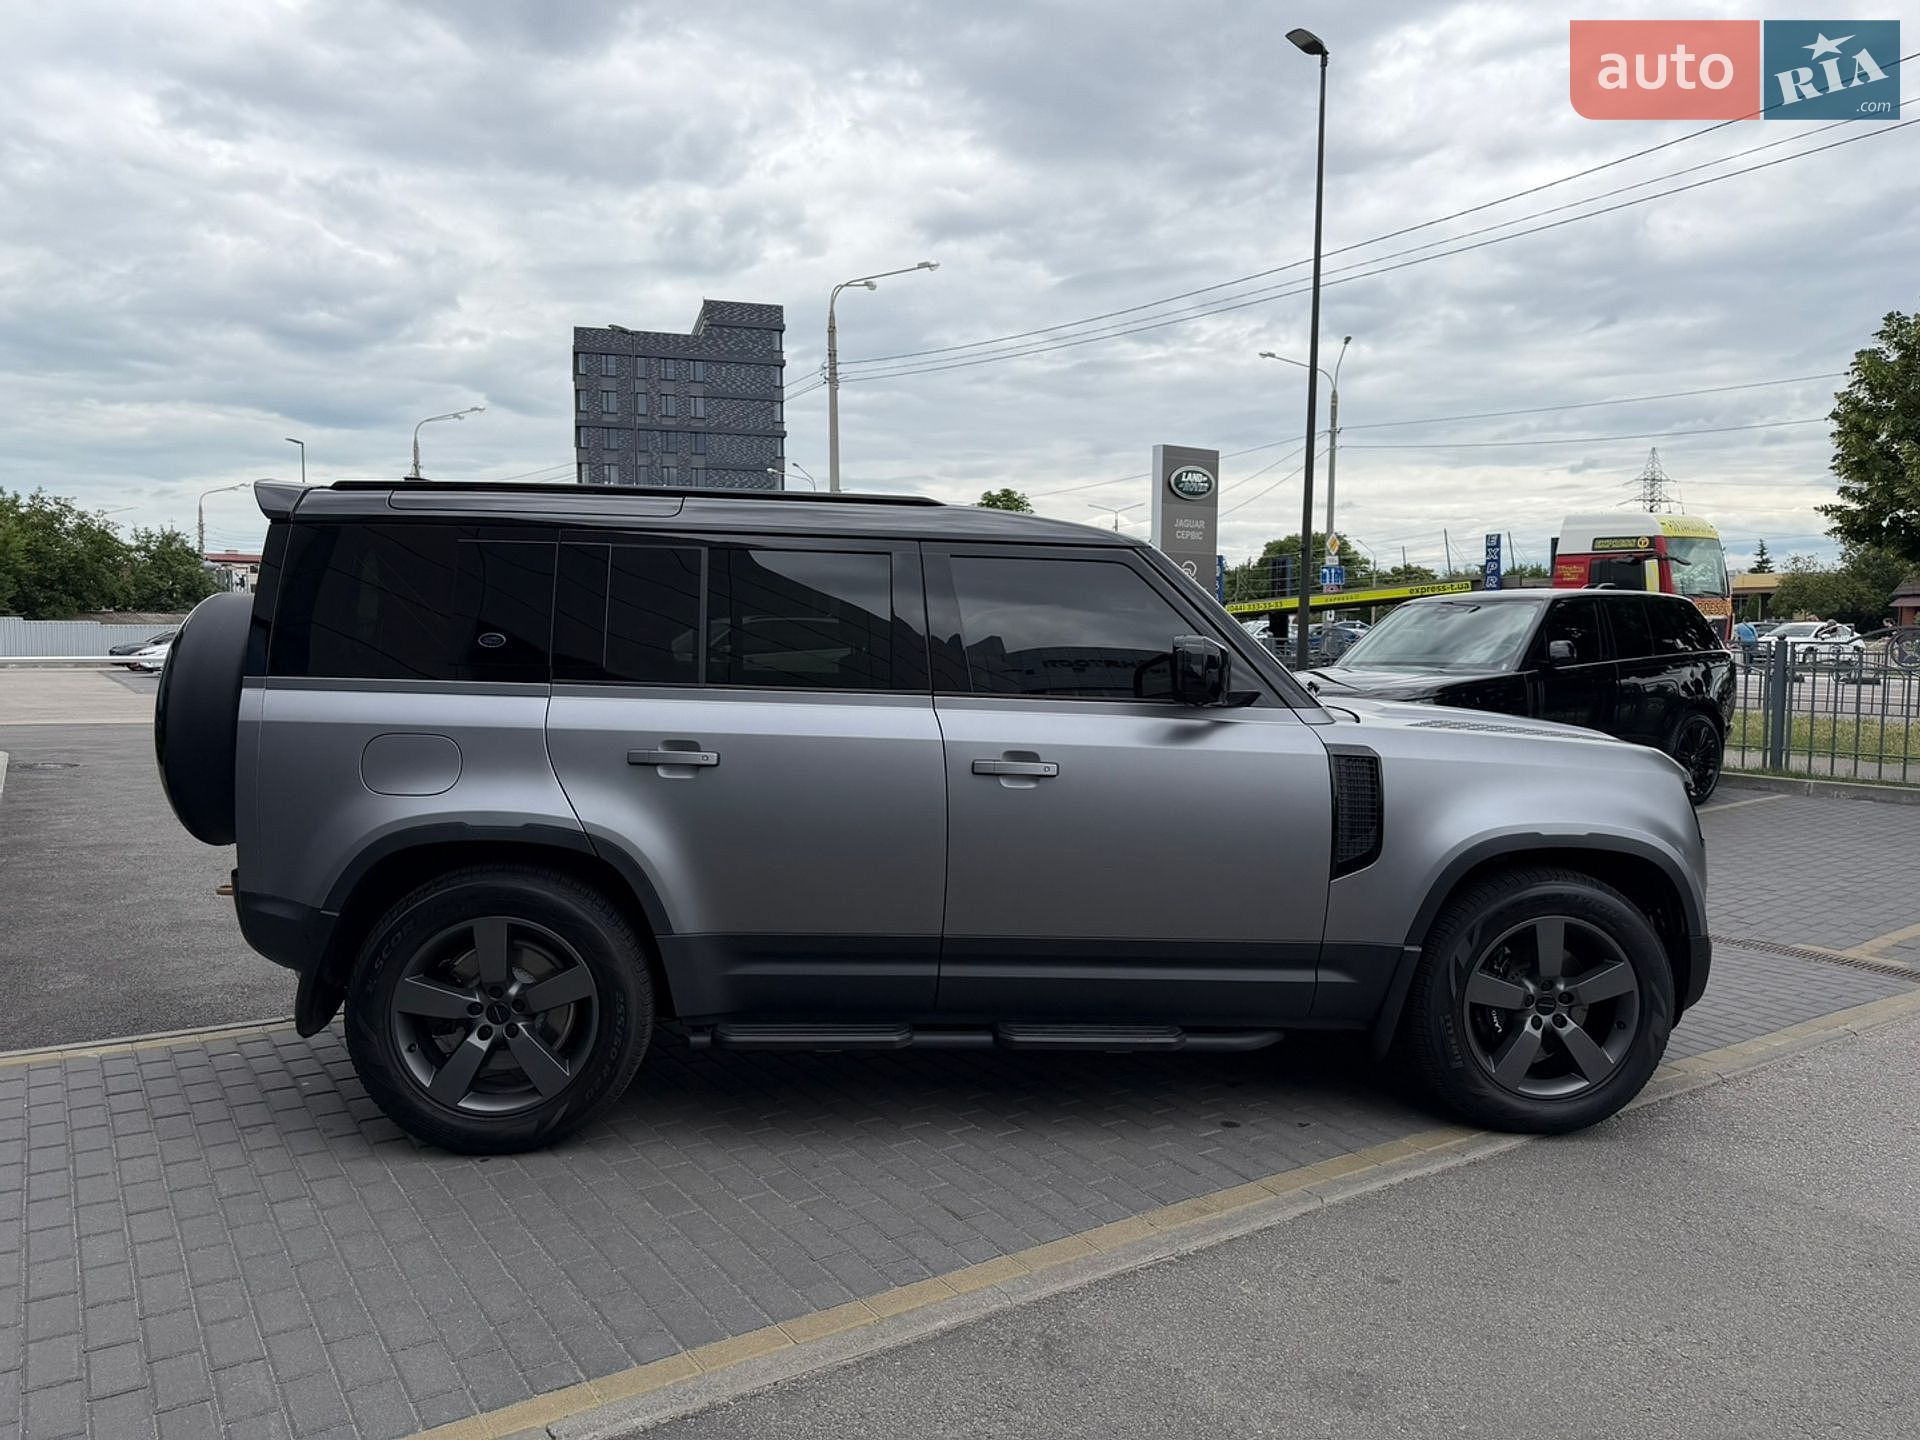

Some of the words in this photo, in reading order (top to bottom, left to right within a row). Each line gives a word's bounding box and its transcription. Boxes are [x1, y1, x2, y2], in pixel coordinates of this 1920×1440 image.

[1182, 472, 1204, 482] LAND
[1174, 518, 1205, 529] JAGUAR
[1409, 583, 1470, 595] express-t.ua
